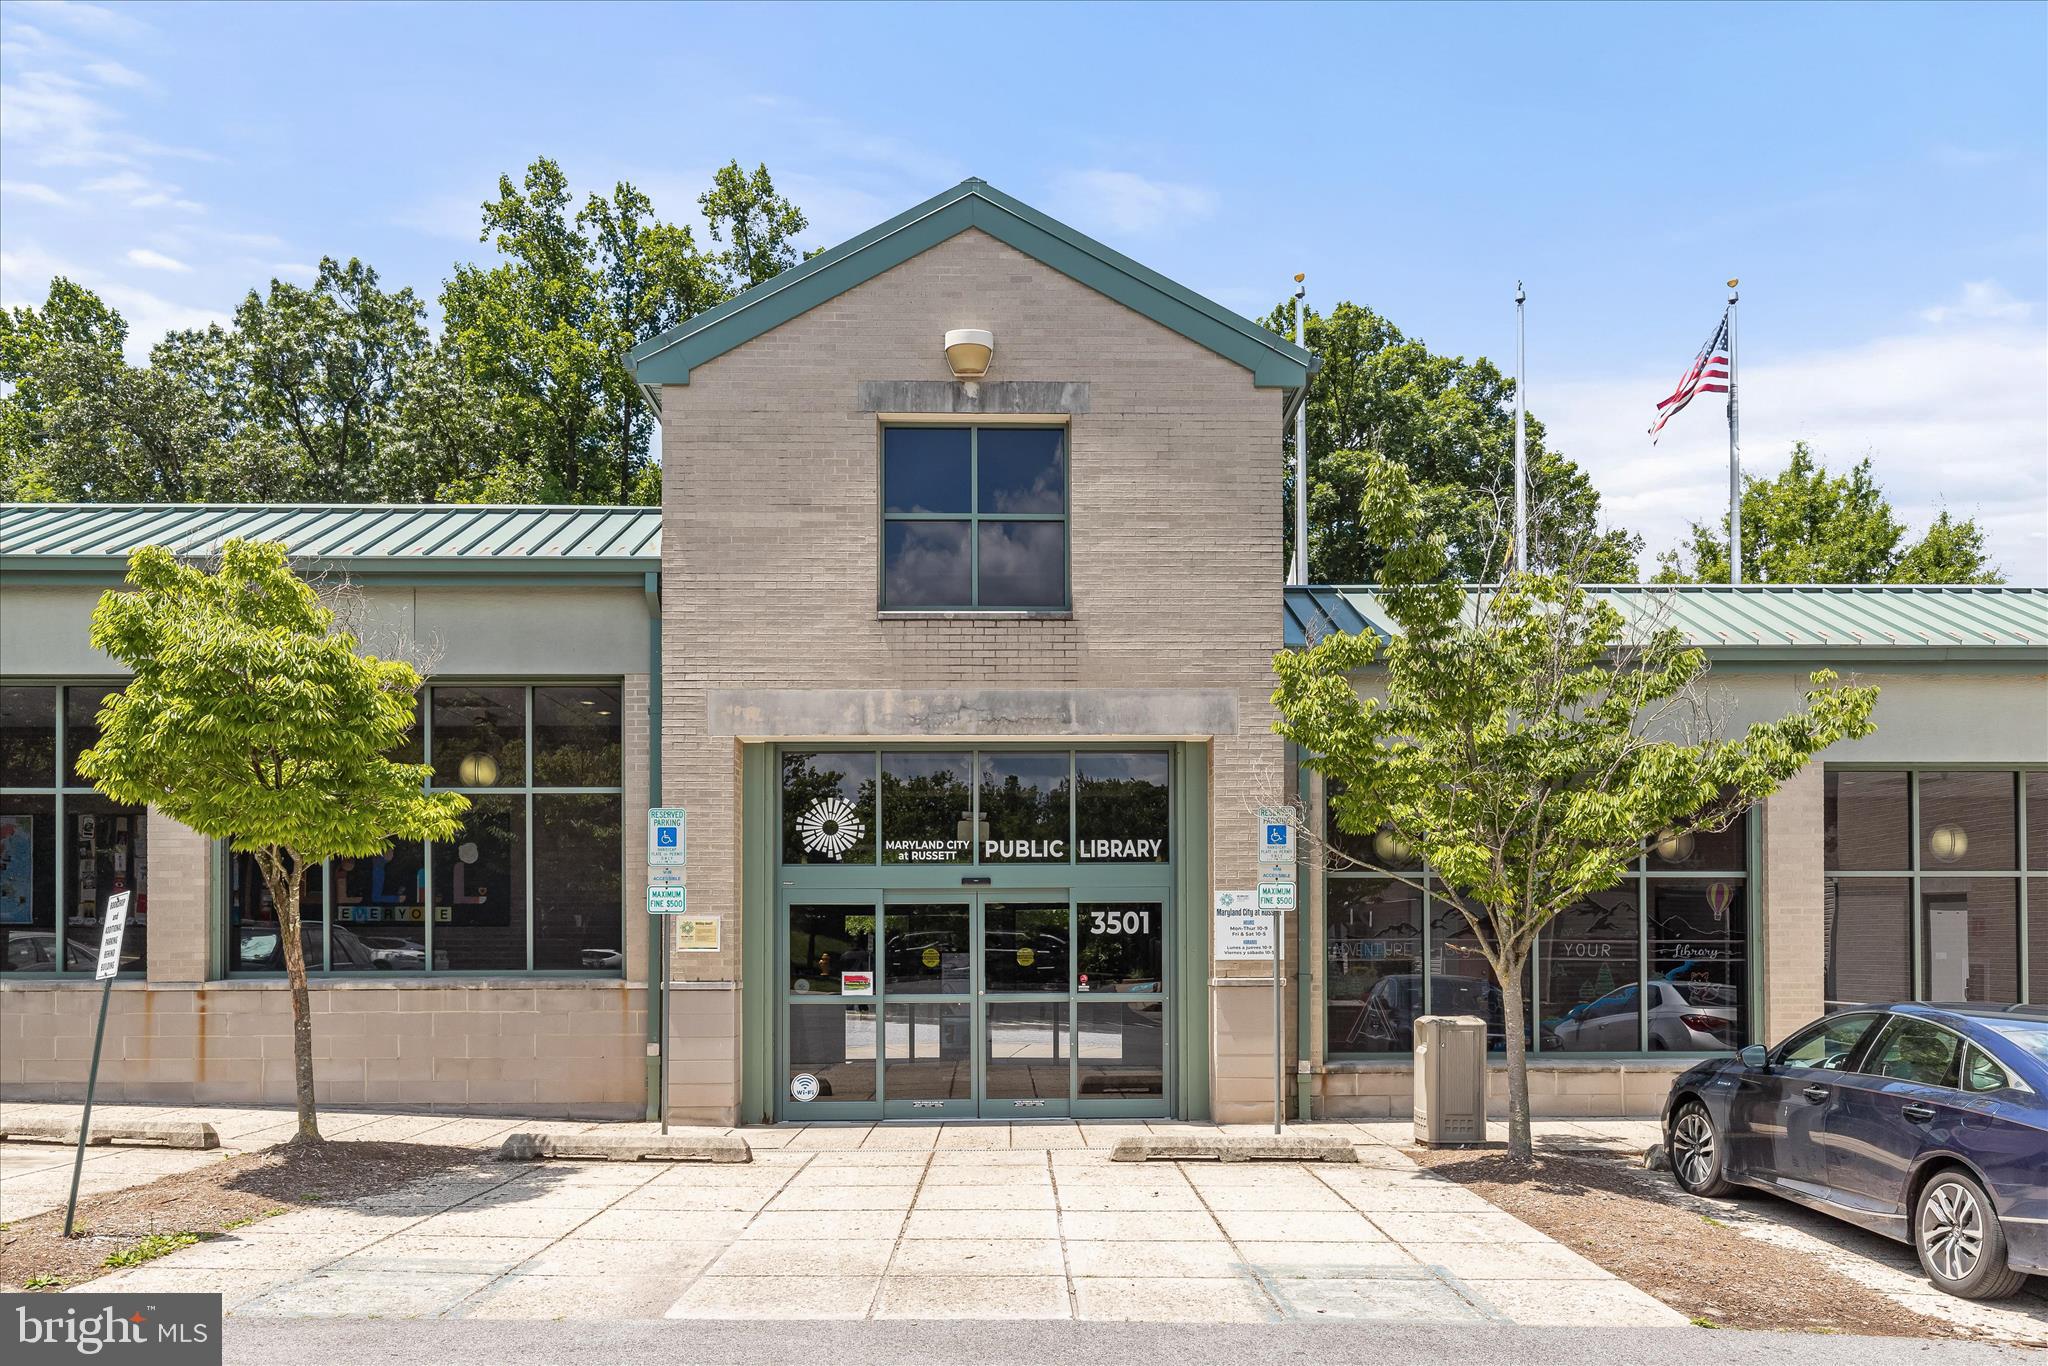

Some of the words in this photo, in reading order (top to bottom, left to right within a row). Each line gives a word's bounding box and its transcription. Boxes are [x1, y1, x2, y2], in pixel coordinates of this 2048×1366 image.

[650, 810, 684, 818] RESERVED
[653, 818, 681, 827] PARKING
[885, 840, 944, 850] MARYLAND
[946, 840, 970, 850] CITY
[985, 839, 1064, 858] PUBLIC
[1080, 839, 1162, 858] LIBRARY
[898, 851, 909, 860] at
[911, 851, 957, 860] RUSSETT
[652, 890, 682, 898] MAXIMUM
[1262, 887, 1291, 895] MAXIMUM
[342, 908, 449, 920] EVERYOE
[1216, 908, 1242, 918] Maryland
[1243, 908, 1254, 918] City
[1090, 911, 1149, 934] 3501
[105, 936, 118, 947] PARKING
[1335, 942, 1414, 957] ADVENTURE
[1564, 943, 1611, 957] YOUR
[1672, 943, 1719, 959] Library
